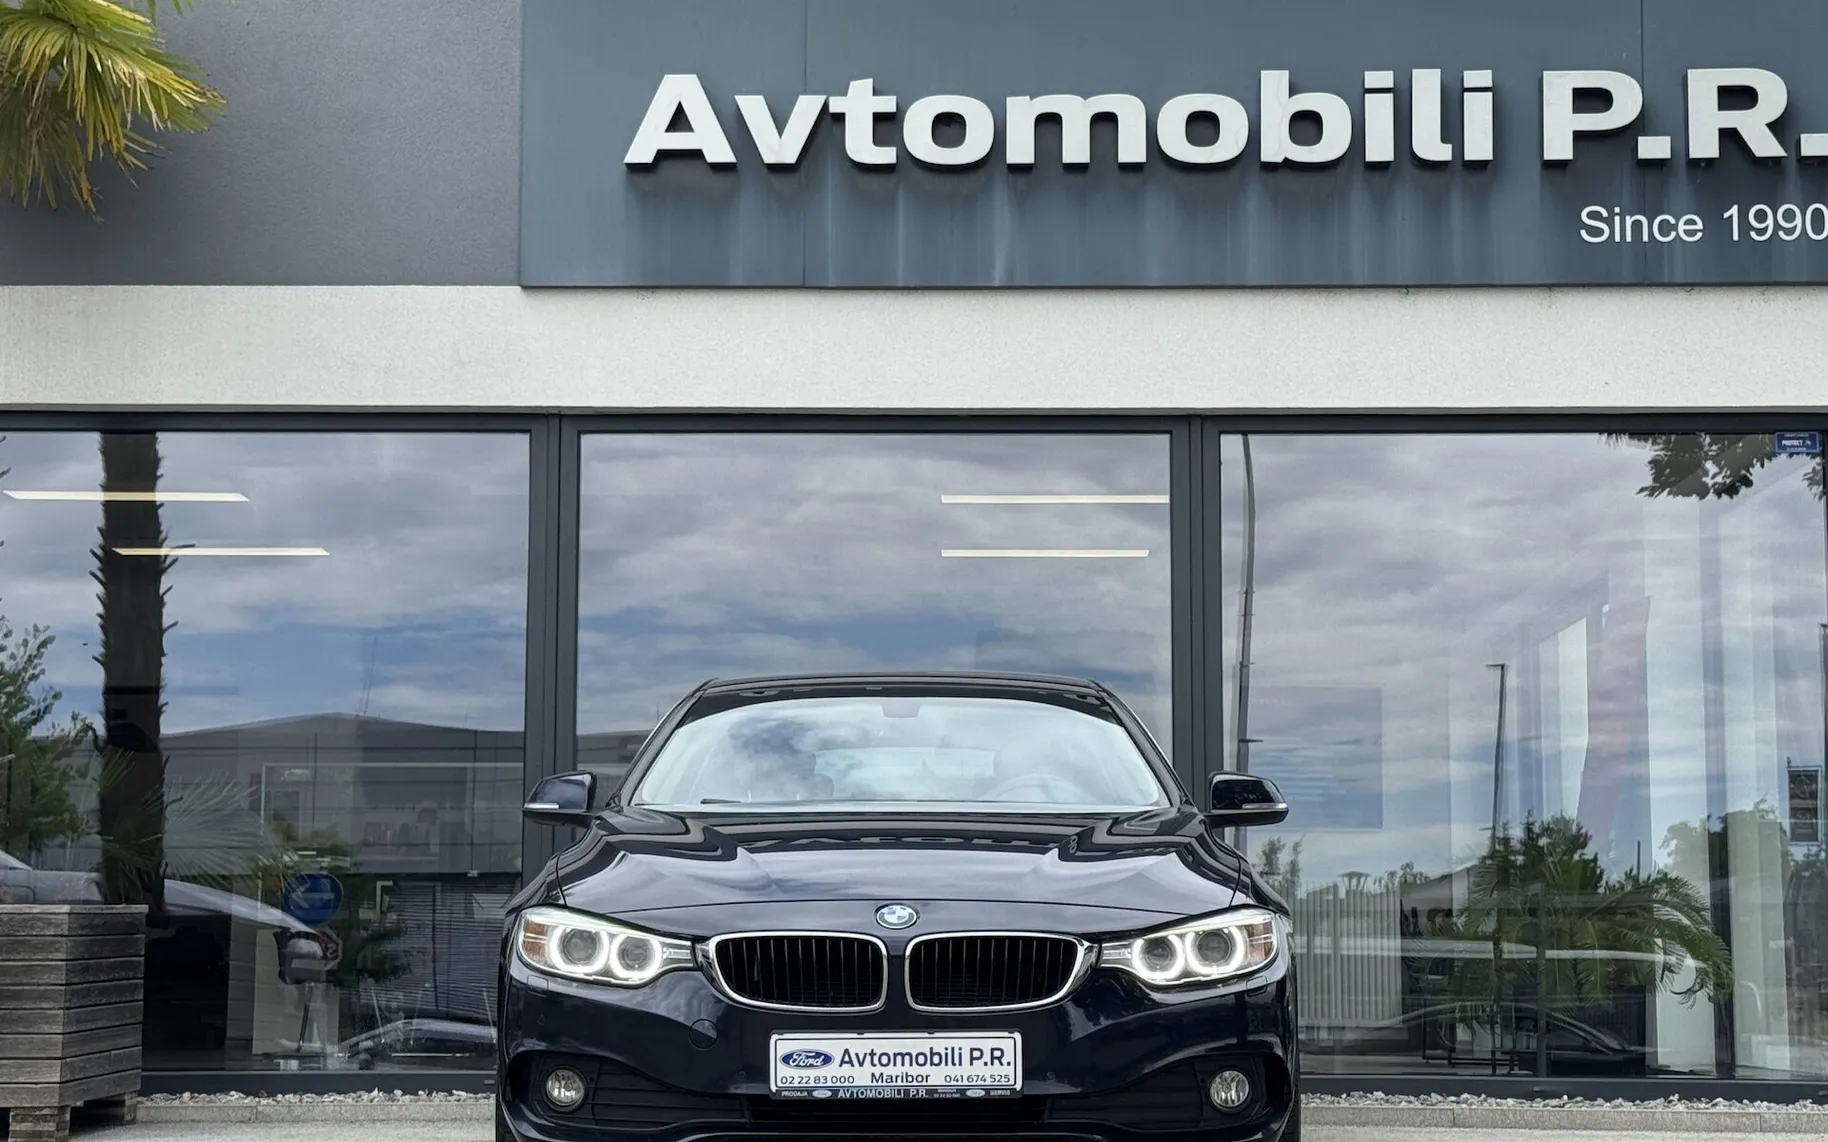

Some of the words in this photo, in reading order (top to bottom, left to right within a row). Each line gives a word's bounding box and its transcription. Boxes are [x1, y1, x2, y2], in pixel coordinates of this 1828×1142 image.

[623, 69, 1495, 168] Avtomobili
[1541, 67, 1828, 164] P.R.
[1580, 205, 1704, 243] Since
[1722, 203, 1828, 242] 1990
[789, 1051, 825, 1067] Ford
[838, 1046, 963, 1068] Avtomobili
[969, 1047, 1012, 1067] P.R.
[780, 1075, 796, 1085] 02
[797, 1075, 812, 1085] 22
[813, 1075, 829, 1085] 83
[830, 1075, 855, 1085] 000
[870, 1072, 931, 1084] Maribor
[944, 1074, 964, 1084] 041
[966, 1074, 988, 1084] 674
[989, 1074, 1011, 1084] 525
[837, 1088, 904, 1099] AVTOMOBILI
[909, 1088, 929, 1098] P.R.
